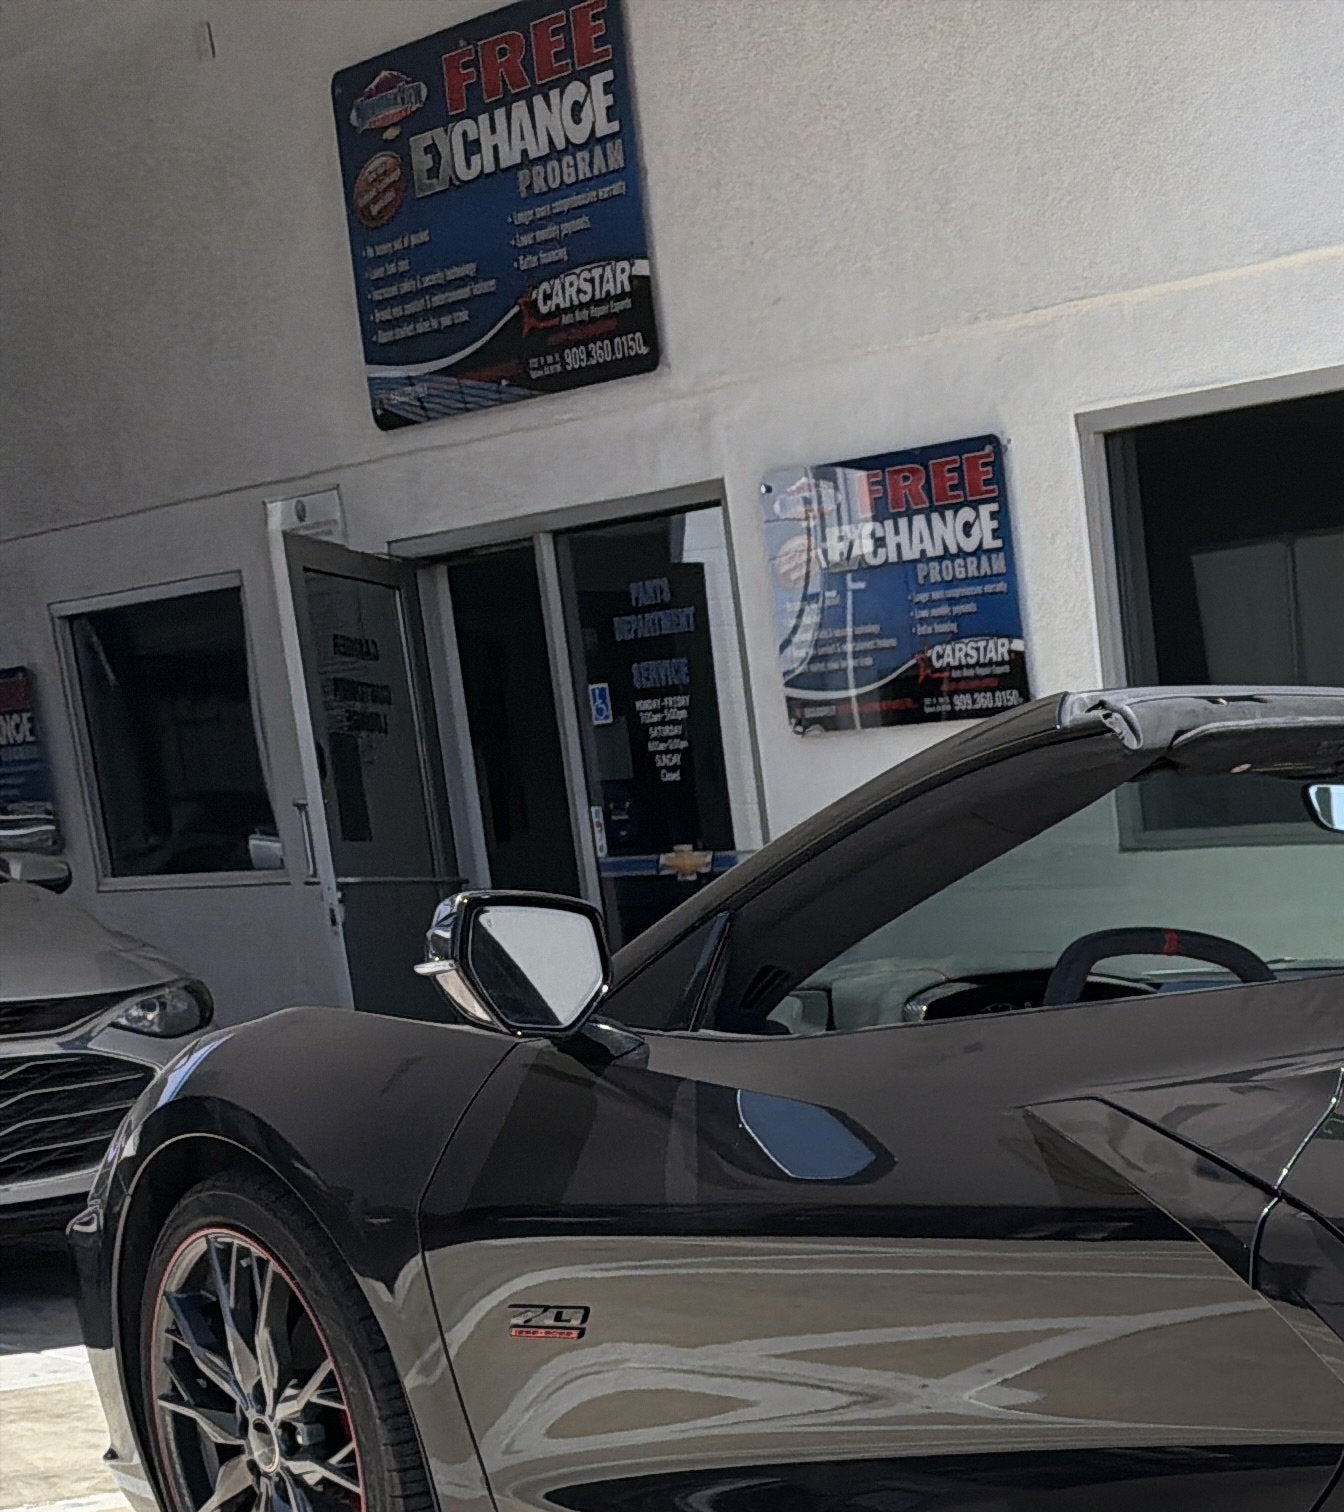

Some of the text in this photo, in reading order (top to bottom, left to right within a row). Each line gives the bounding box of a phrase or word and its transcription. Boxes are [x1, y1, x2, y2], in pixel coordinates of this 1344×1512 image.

[441, 0, 612, 115] FREE
[409, 70, 620, 198] EXCHANGE
[518, 139, 625, 198] PROGRAM
[537, 260, 632, 314] CARSTAR
[564, 331, 644, 371] 909.360.0150
[857, 450, 998, 516] FREE
[825, 502, 1003, 575] EXCHANGE
[916, 552, 1006, 585] PROGRAM
[613, 606, 695, 641] DEPARTMENT
[931, 637, 1011, 669] CARSTAR
